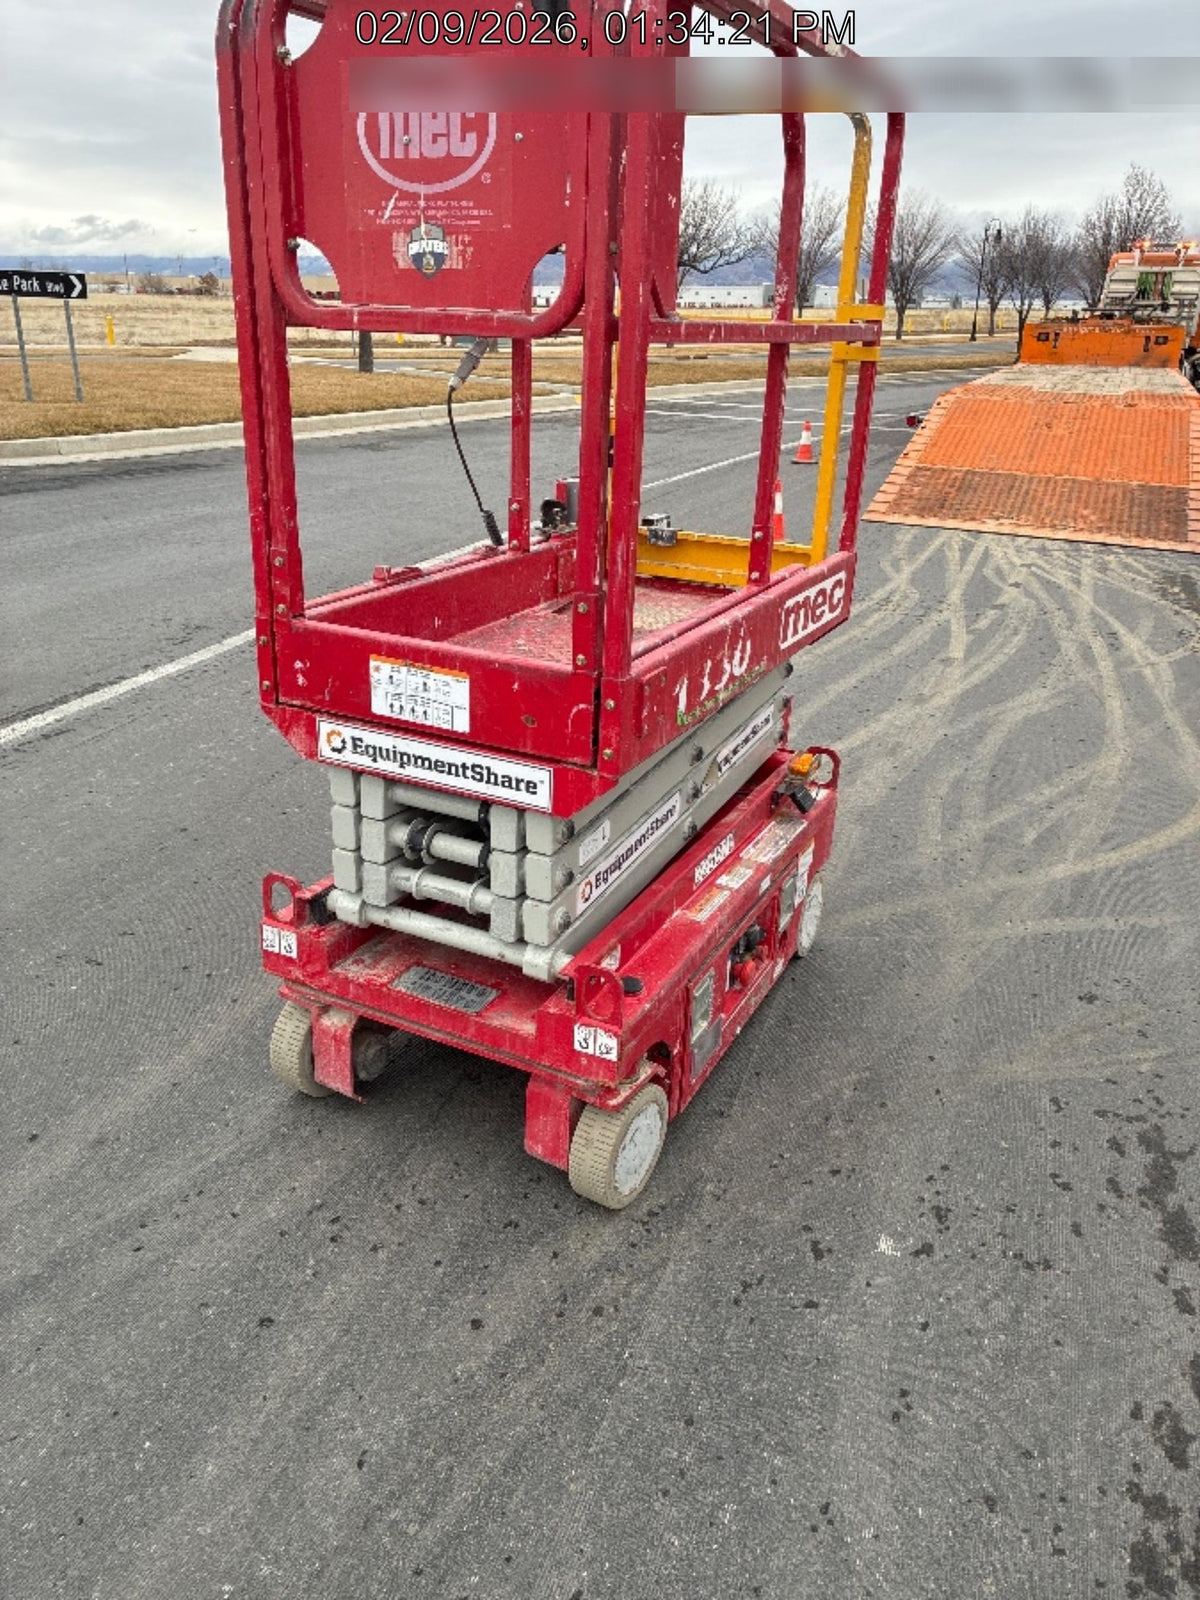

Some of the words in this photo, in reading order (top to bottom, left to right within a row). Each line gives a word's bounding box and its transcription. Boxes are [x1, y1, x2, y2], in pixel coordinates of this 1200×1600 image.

[13, 275, 41, 292] Park
[780, 578, 844, 648] mec
[351, 735, 538, 796] EquipmentShare
